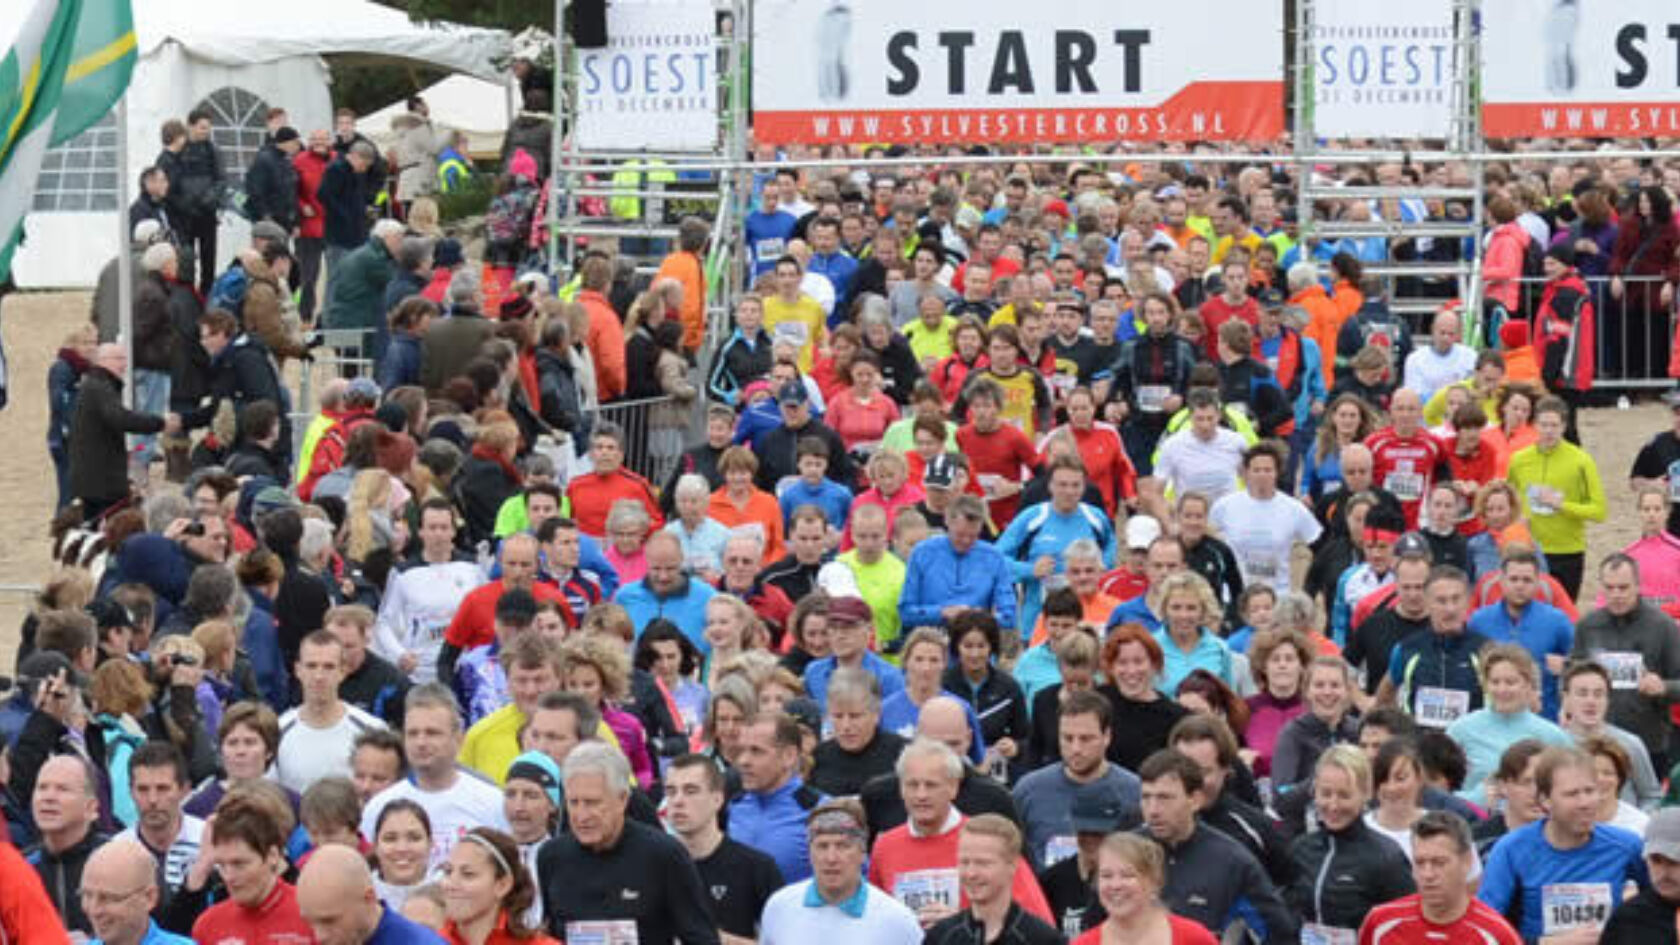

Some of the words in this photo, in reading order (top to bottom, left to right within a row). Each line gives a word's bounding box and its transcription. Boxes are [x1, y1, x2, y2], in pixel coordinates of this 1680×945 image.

[583, 53, 709, 95] SOEST
[885, 29, 1151, 95] START
[1320, 44, 1446, 86] SOEST
[616, 98, 707, 111] DECEMBER
[1353, 90, 1444, 104] DECEMBER
[812, 110, 1226, 137] WWW.SYLVESTERCROSS.NL
